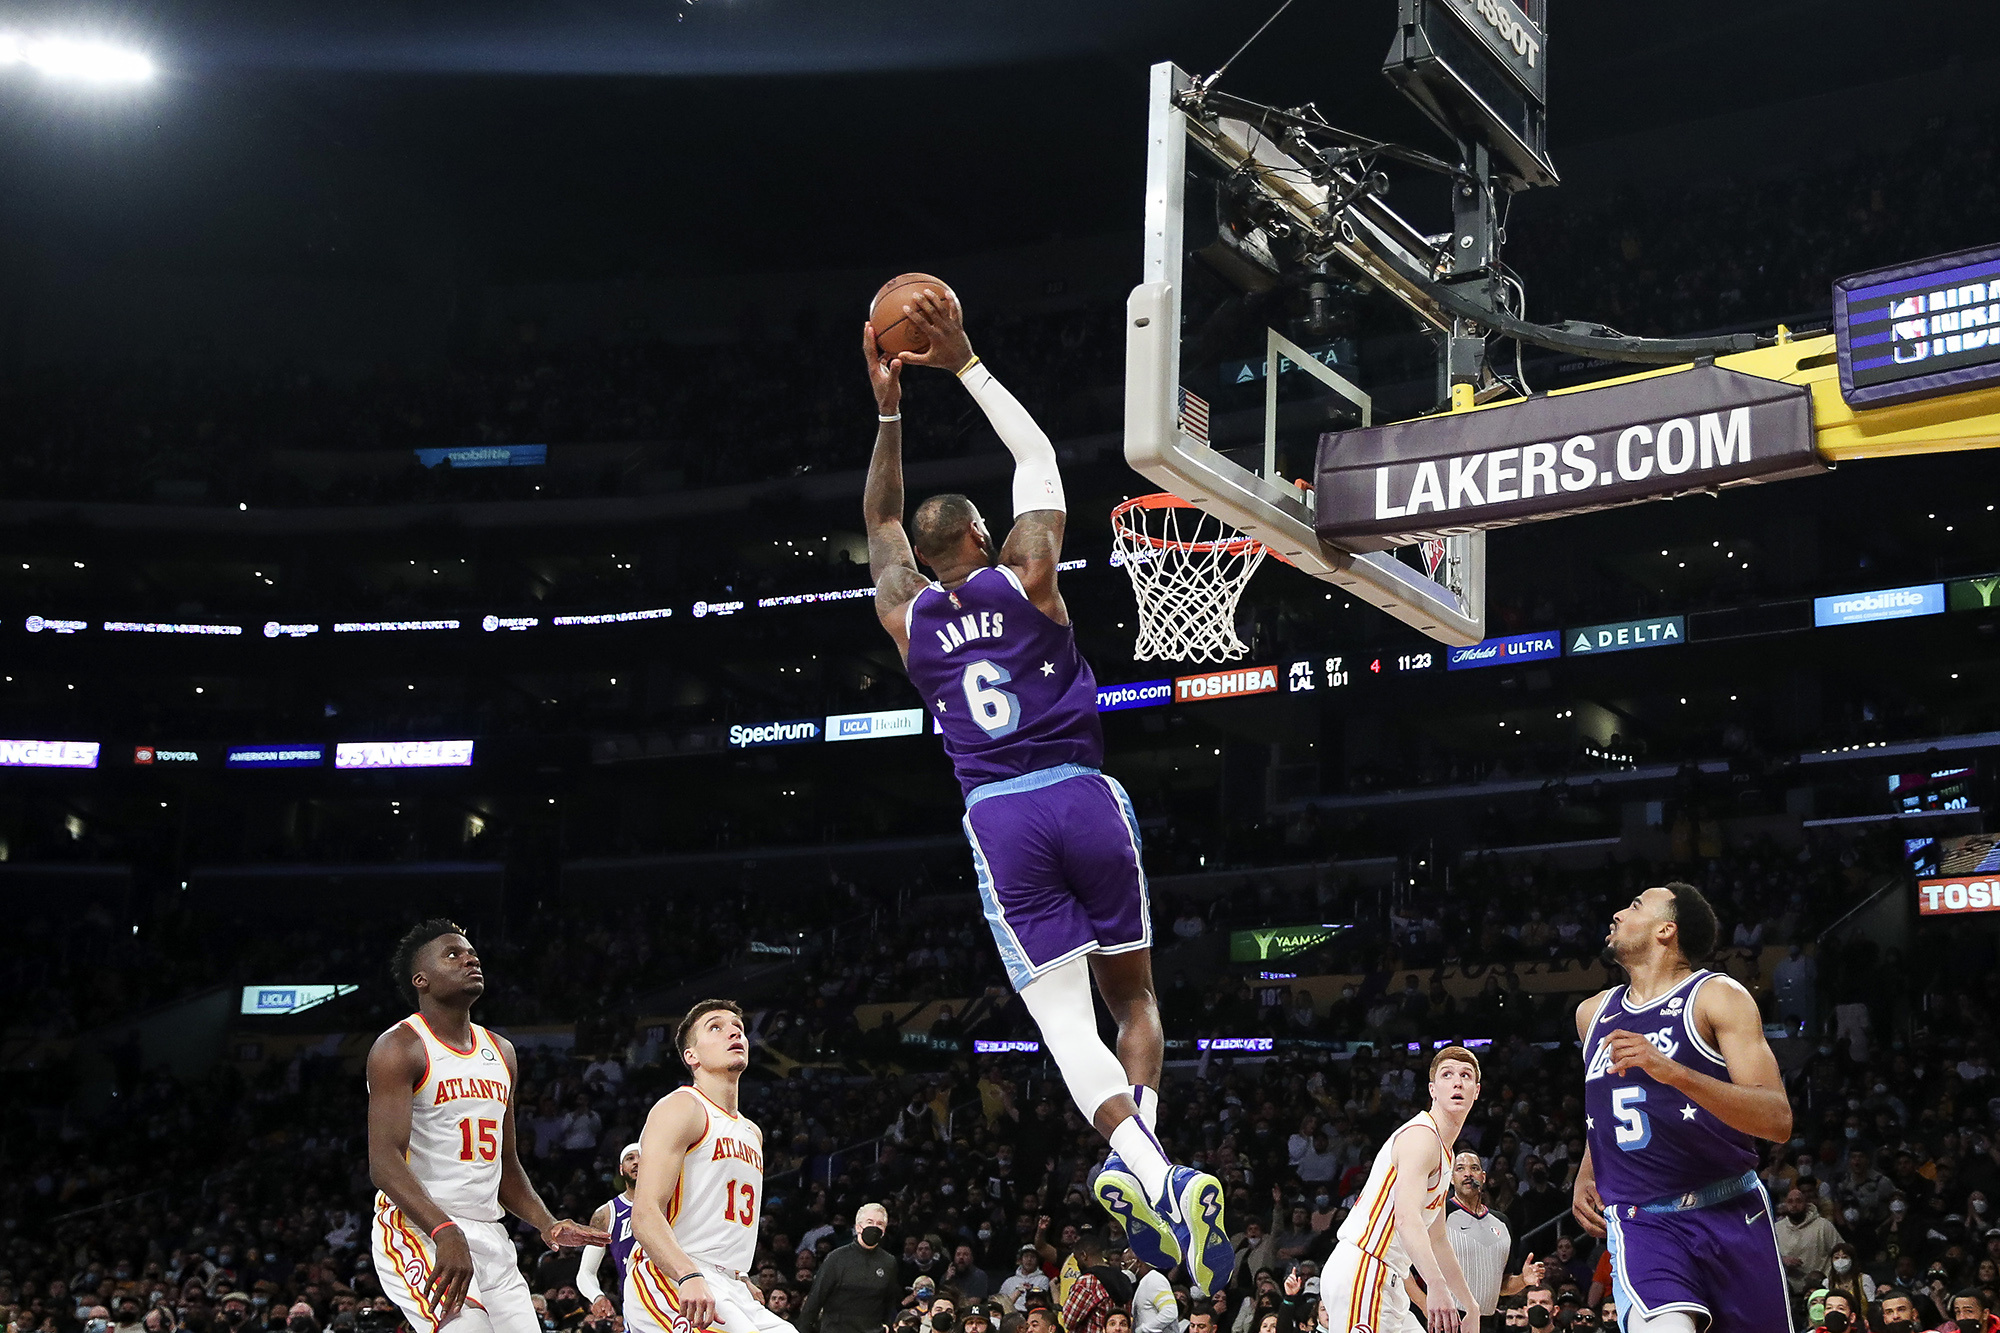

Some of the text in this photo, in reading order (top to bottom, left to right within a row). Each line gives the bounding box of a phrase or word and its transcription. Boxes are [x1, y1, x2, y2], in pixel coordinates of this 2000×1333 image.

[1467, 0, 1539, 68] SSOT
[1375, 406, 1751, 520] LAKERS.COM
[1833, 591, 1924, 614] mobilitie
[936, 612, 1004, 653] JAMES
[1599, 622, 1678, 647] DELTA
[1452, 638, 1554, 663] Michelob ULTRA
[1289, 653, 1433, 677] ATL 87 4 11:23
[1178, 669, 1276, 698] TOSHIBA
[1289, 671, 1348, 692] LAL 101
[962, 659, 1021, 739] 6
[1096, 685, 1171, 707] rypto.com
[730, 721, 815, 748] Spectrum
[842, 716, 912, 733] UCLA Health
[0, 742, 98, 766] NGELES
[155, 750, 199, 762] TOYOTA
[229, 751, 278, 762] AMERICAN
[1659, 1007, 1683, 1017] bibigo
[1612, 1085, 1652, 1151] 5
[459, 1117, 498, 1162] 15
[711, 1137, 763, 1175] ATLANT
[724, 1178, 755, 1228] 13
